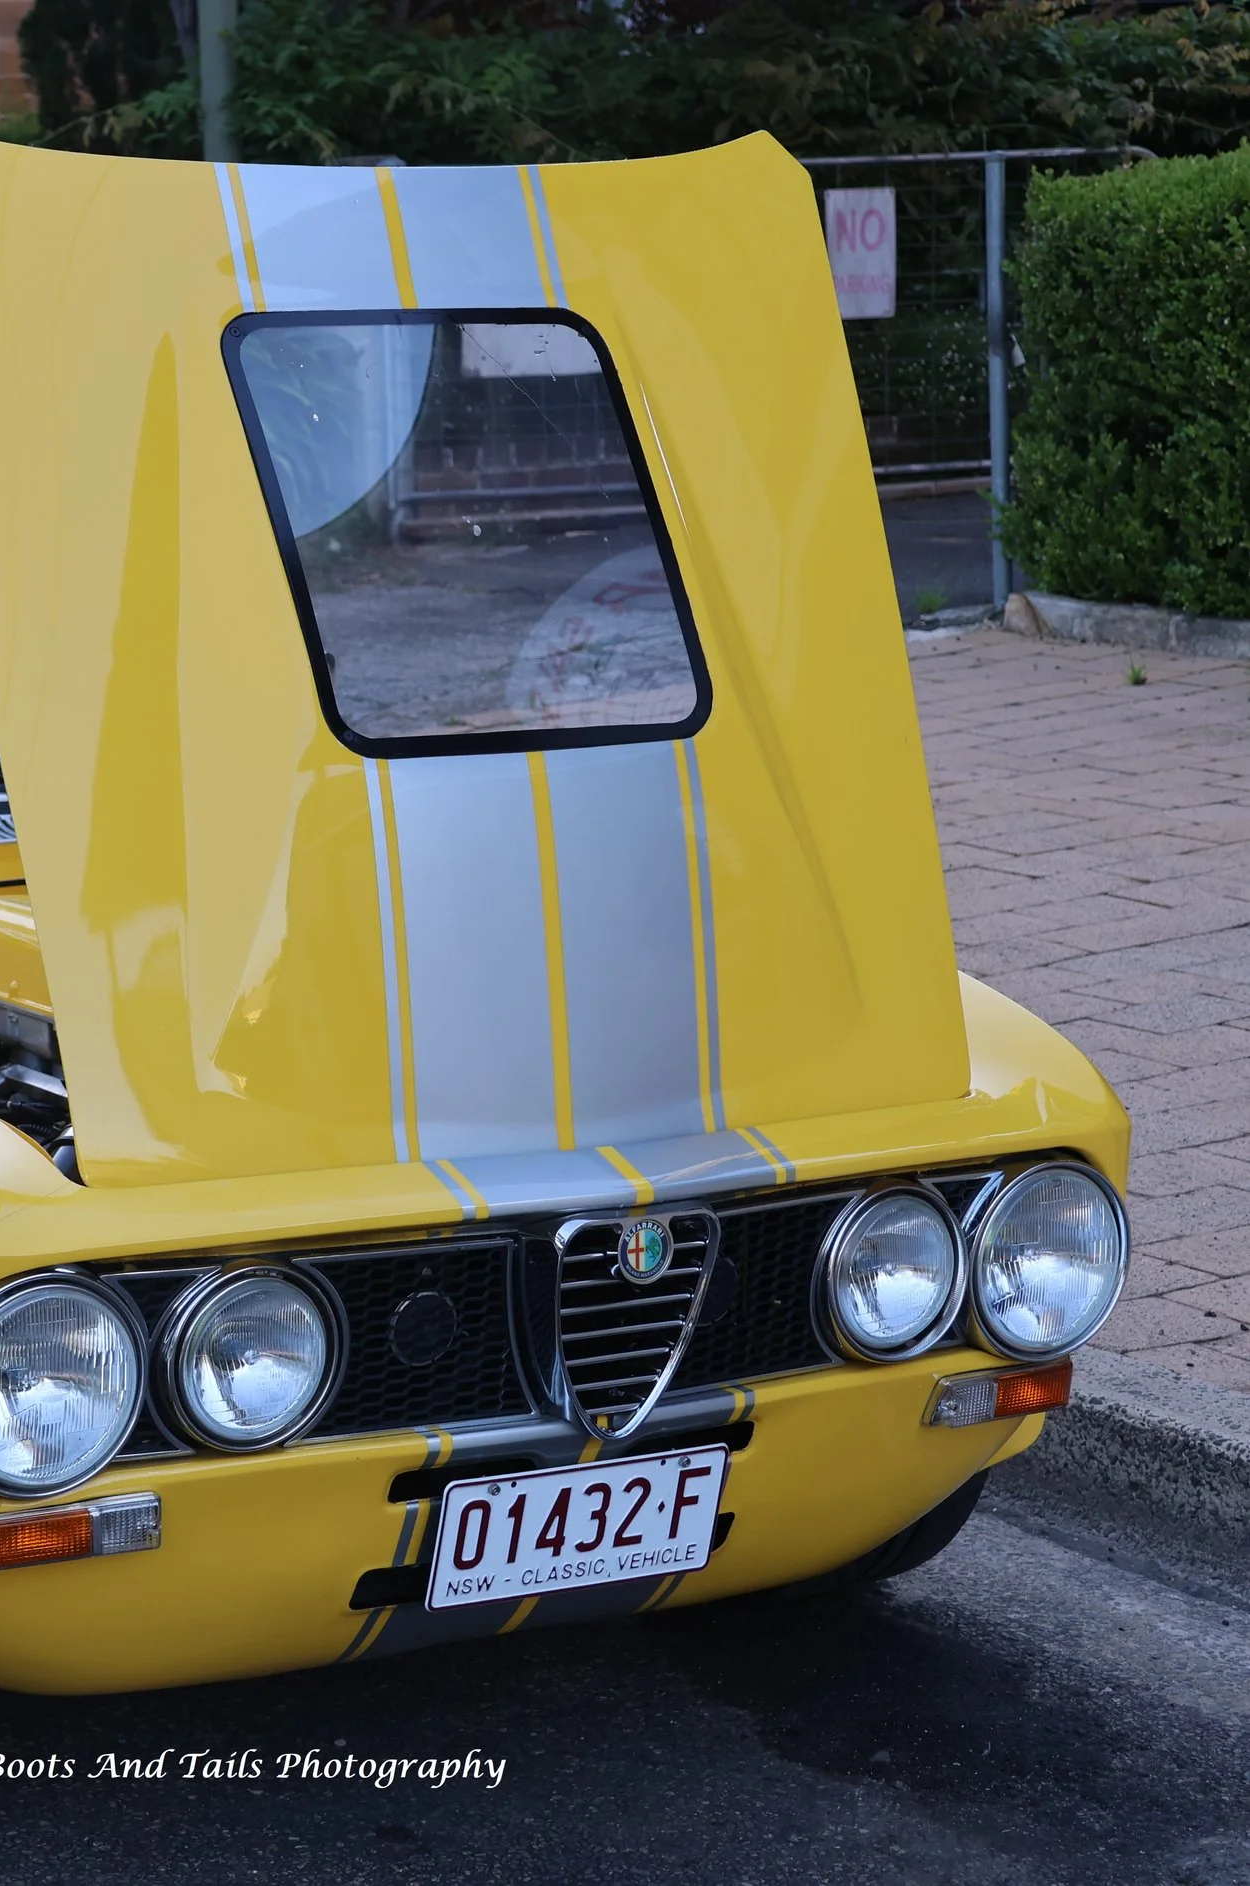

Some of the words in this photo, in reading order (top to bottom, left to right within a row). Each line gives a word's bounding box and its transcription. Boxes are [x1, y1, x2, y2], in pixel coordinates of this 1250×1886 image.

[835, 207, 886, 253] NO
[446, 1575, 496, 1598] NSW
[521, 1558, 605, 1586] CLASSIC
[617, 1543, 698, 1572] VEHICLE
